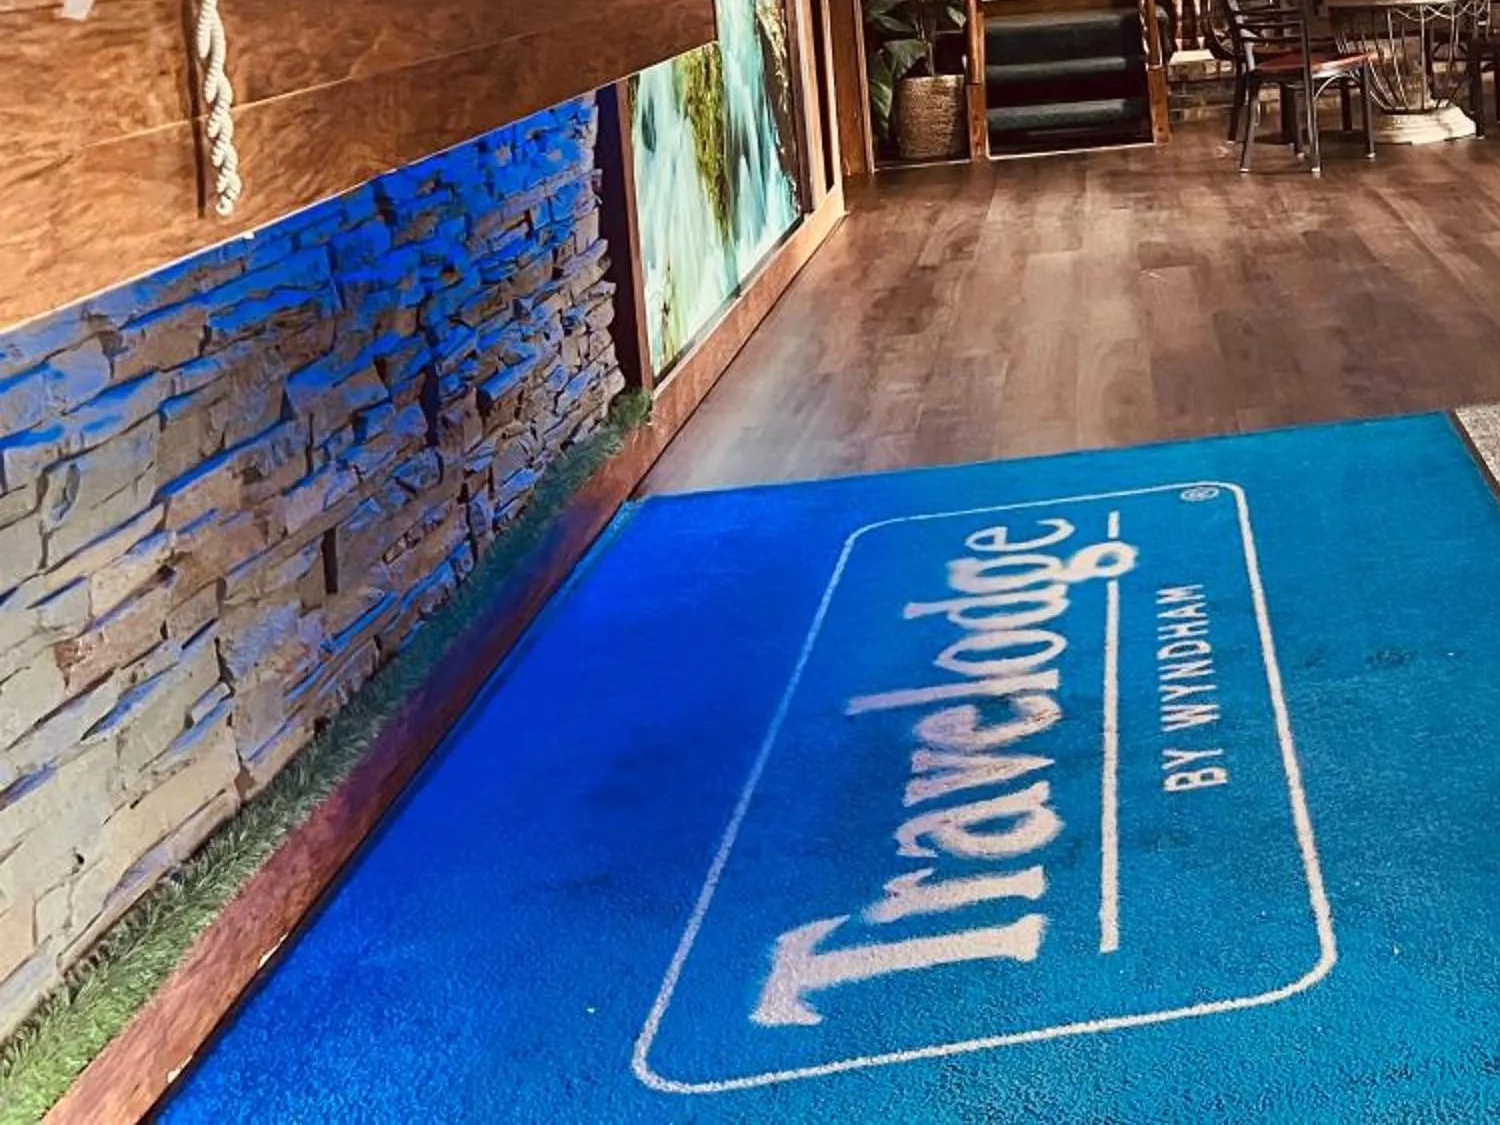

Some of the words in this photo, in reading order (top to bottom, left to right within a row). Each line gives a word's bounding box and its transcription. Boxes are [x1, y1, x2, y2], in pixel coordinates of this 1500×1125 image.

[1155, 584, 1221, 732] WYNDHAM
[748, 518, 1138, 1026] Travelodge
[1162, 748, 1228, 792] BY
